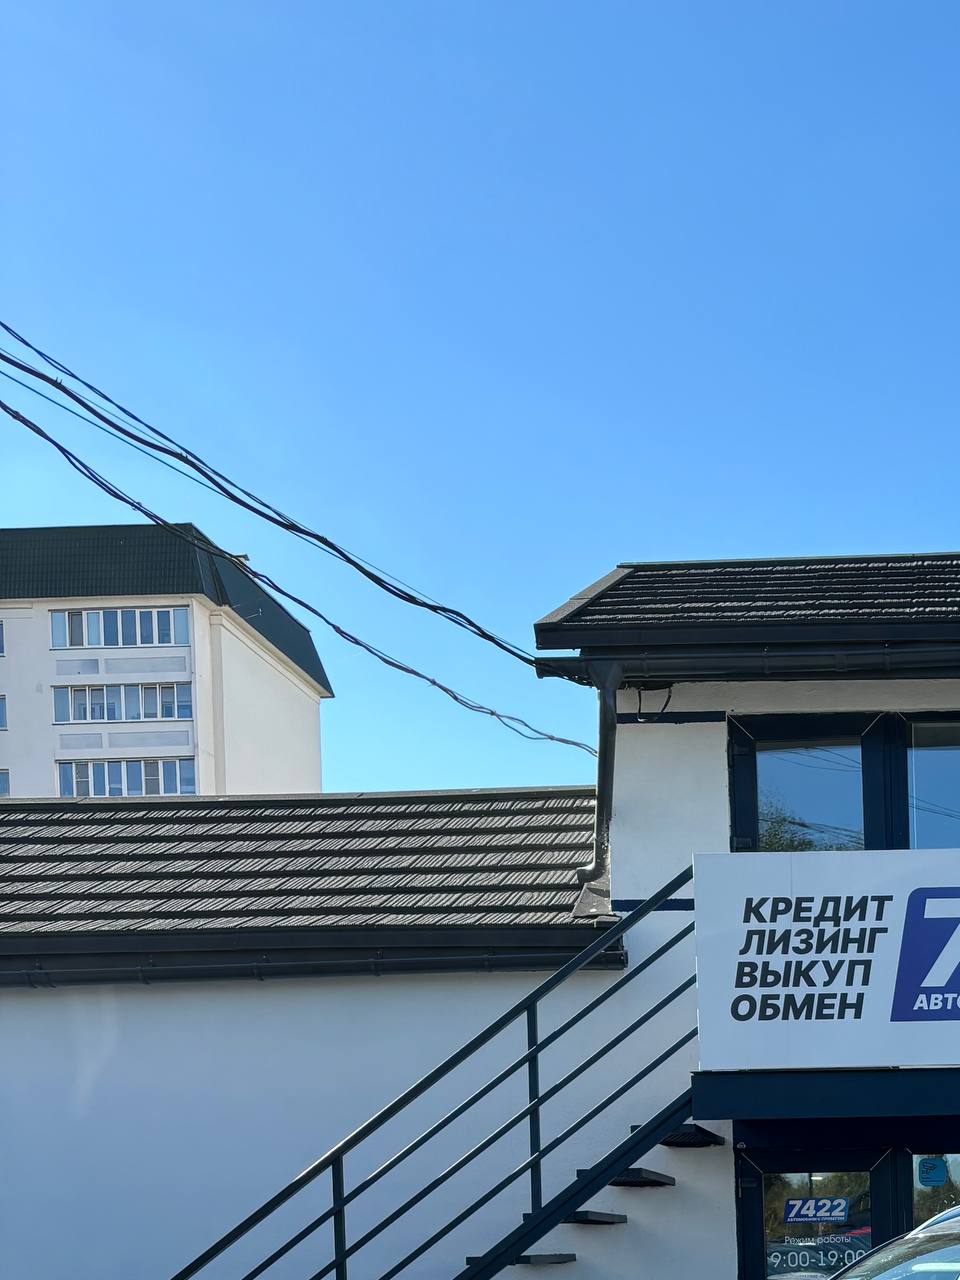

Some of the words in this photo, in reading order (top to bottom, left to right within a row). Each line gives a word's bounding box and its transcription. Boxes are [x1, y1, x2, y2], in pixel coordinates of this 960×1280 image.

[743, 895, 893, 927] КРЕДИТ
[738, 927, 888, 955] ЛИЗИНГ
[734, 959, 872, 988] ВЫКУП
[730, 992, 864, 1021] ОБМЕН
[788, 1198, 847, 1218] 7422
[817, 1234, 851, 1245] работы
